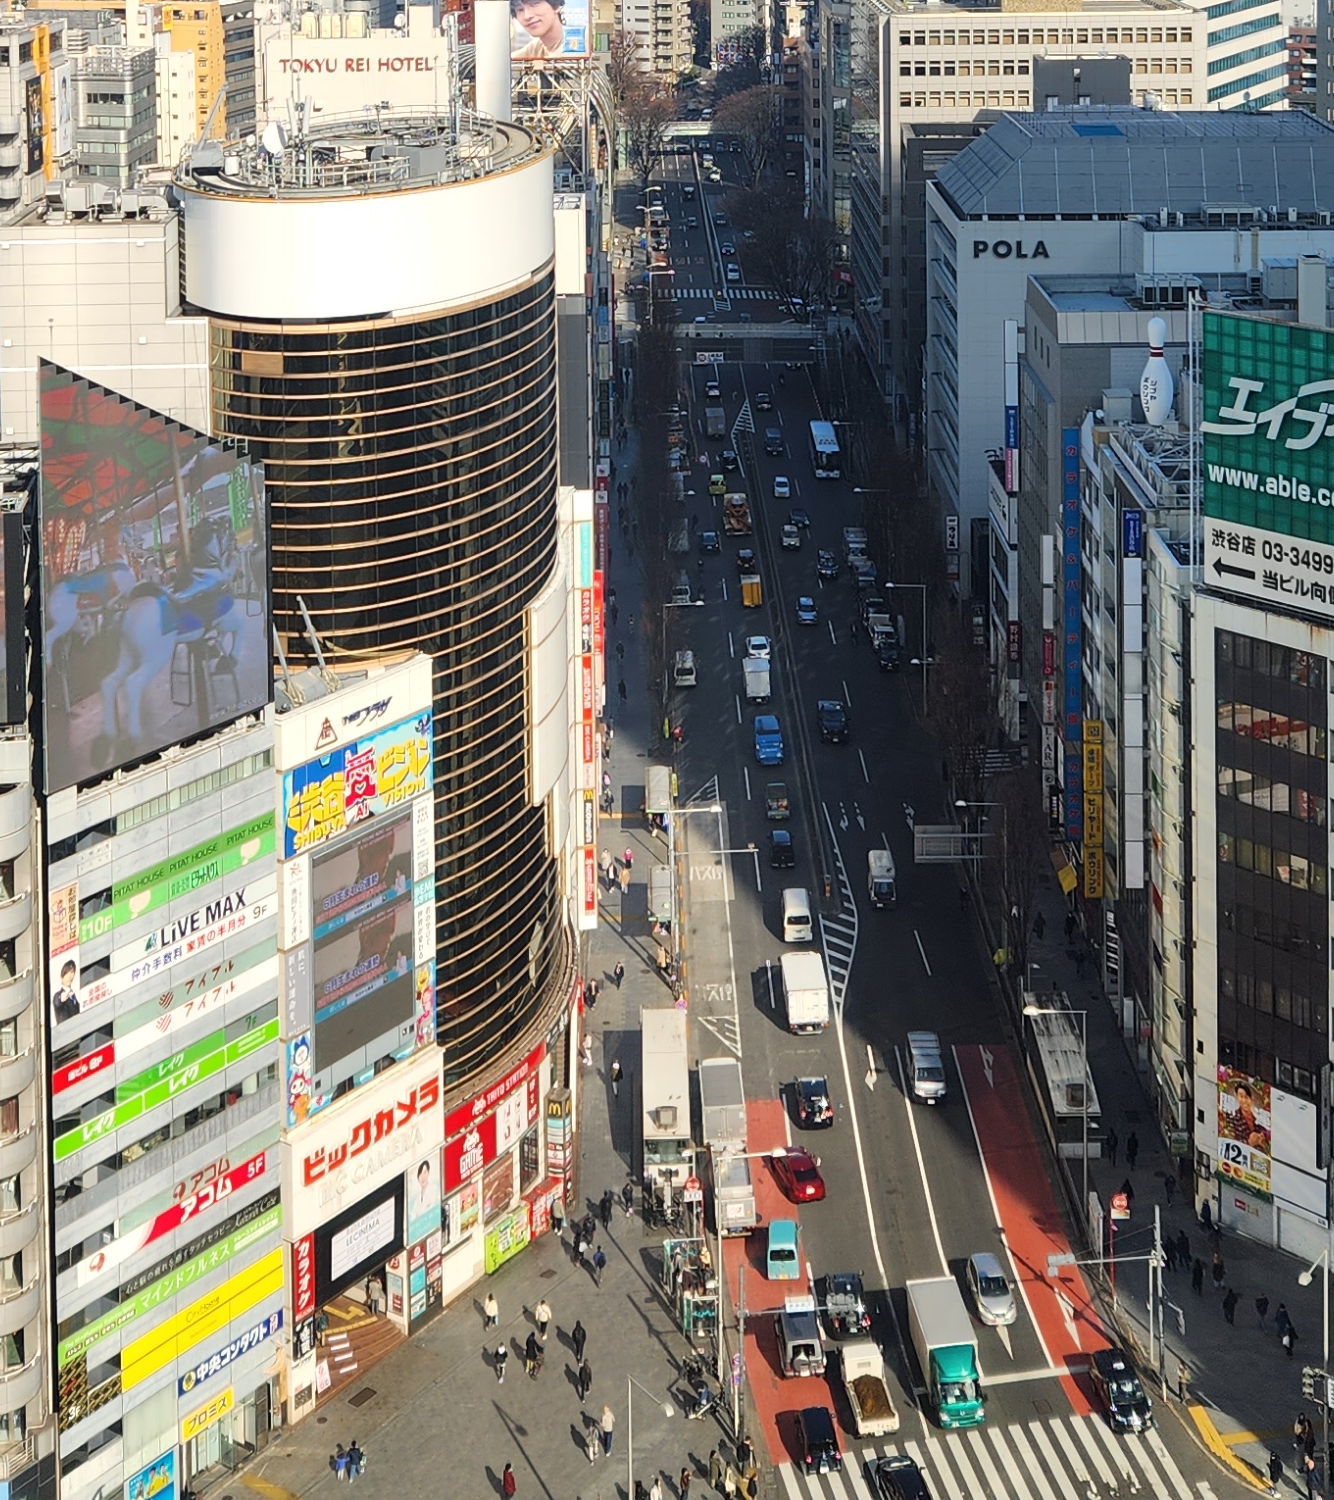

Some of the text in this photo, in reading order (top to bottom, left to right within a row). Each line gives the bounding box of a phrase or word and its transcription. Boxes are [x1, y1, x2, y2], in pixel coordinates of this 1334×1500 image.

[279, 56, 433, 73] TOKYU REI HOTEL
[973, 240, 1050, 258] POLA
[1212, 528, 1256, 556] 渋谷店
[294, 778, 425, 849] SHIBUYA AI VISION
[226, 816, 273, 846] PITAT HOUSE
[169, 842, 218, 873] PITAT HOUSE
[114, 884, 135, 899] PITAT
[137, 867, 165, 891] HOUSE
[206, 886, 246, 926] MAX
[252, 905, 267, 919] 9F
[87, 915, 112, 938] 10F
[131, 914, 246, 981] 仲介手数料 家賃の半月分
[245, 1015, 258, 1030] 7F
[158, 1053, 184, 1077] レイク
[169, 1064, 199, 1093] レイク
[83, 1111, 116, 1141] レイク
[304, 1075, 439, 1187] ビックカメラ
[351, 1126, 423, 1185] CAMERA
[460, 1142, 484, 1175] GAME
[190, 1156, 264, 1194] アコム 5F
[180, 1178, 232, 1224] アコム
[140, 1241, 230, 1307] マインドフルネス
[298, 1241, 310, 1310] カラオケ
[196, 1323, 267, 1381] 中央コンタクト
[68, 1404, 81, 1421] 3F
[188, 1394, 228, 1433] プロミス
